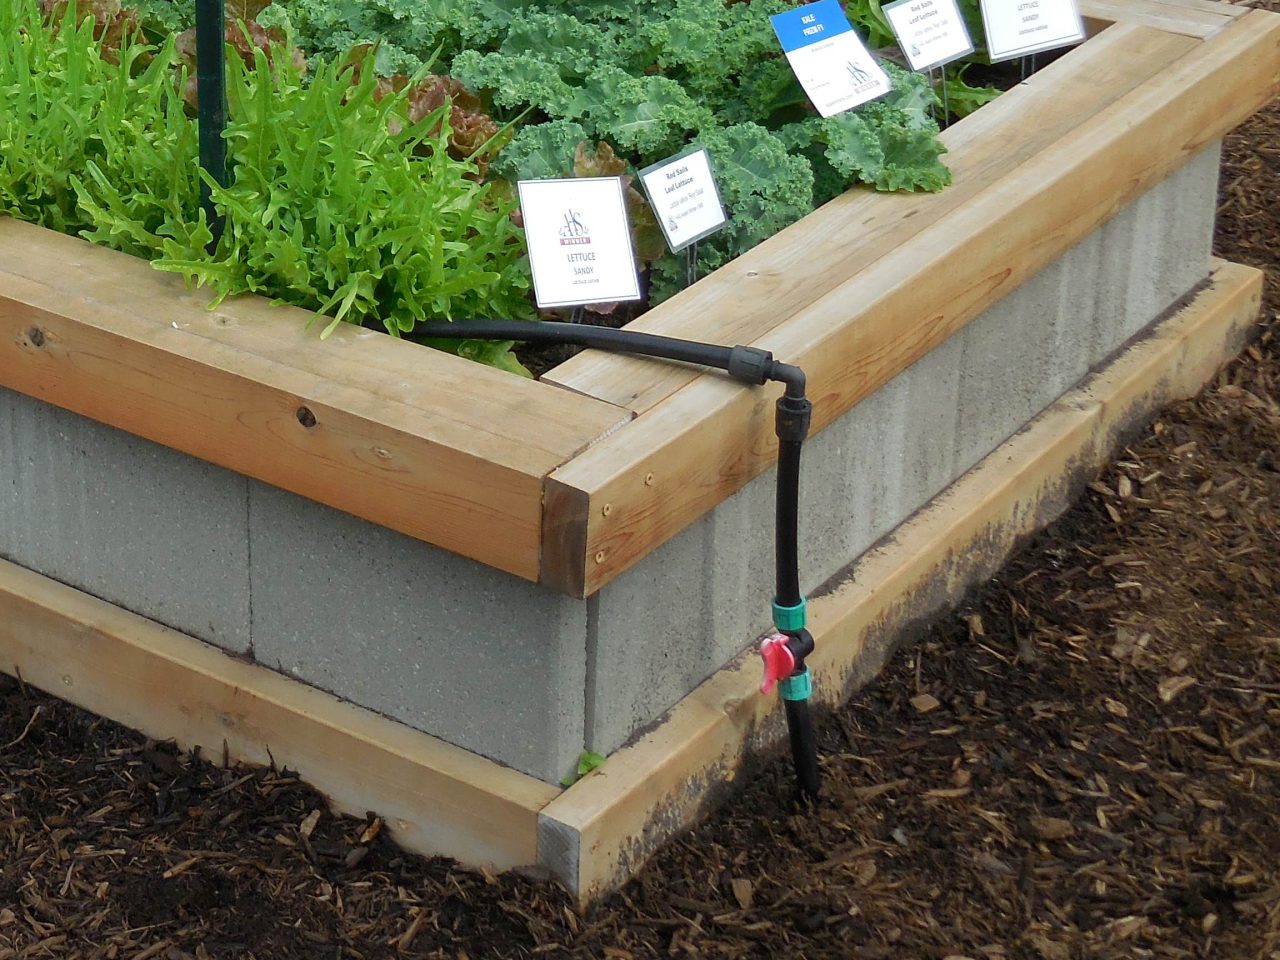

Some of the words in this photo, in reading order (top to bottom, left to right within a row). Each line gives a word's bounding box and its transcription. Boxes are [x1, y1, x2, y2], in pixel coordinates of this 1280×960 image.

[911, 4, 921, 12] Red
[1018, 0, 1039, 11] LETTUCE
[801, 14, 816, 24] KALE
[909, 15, 920, 25] Leaf
[919, 9, 938, 21] Lettuce
[1022, 14, 1039, 23] SANDY
[675, 166, 689, 176] Sails
[664, 183, 676, 194] Leaf
[674, 177, 694, 190] Lettuce
[567, 252, 596, 262] LETTUCE
[574, 267, 594, 275] SANDY
